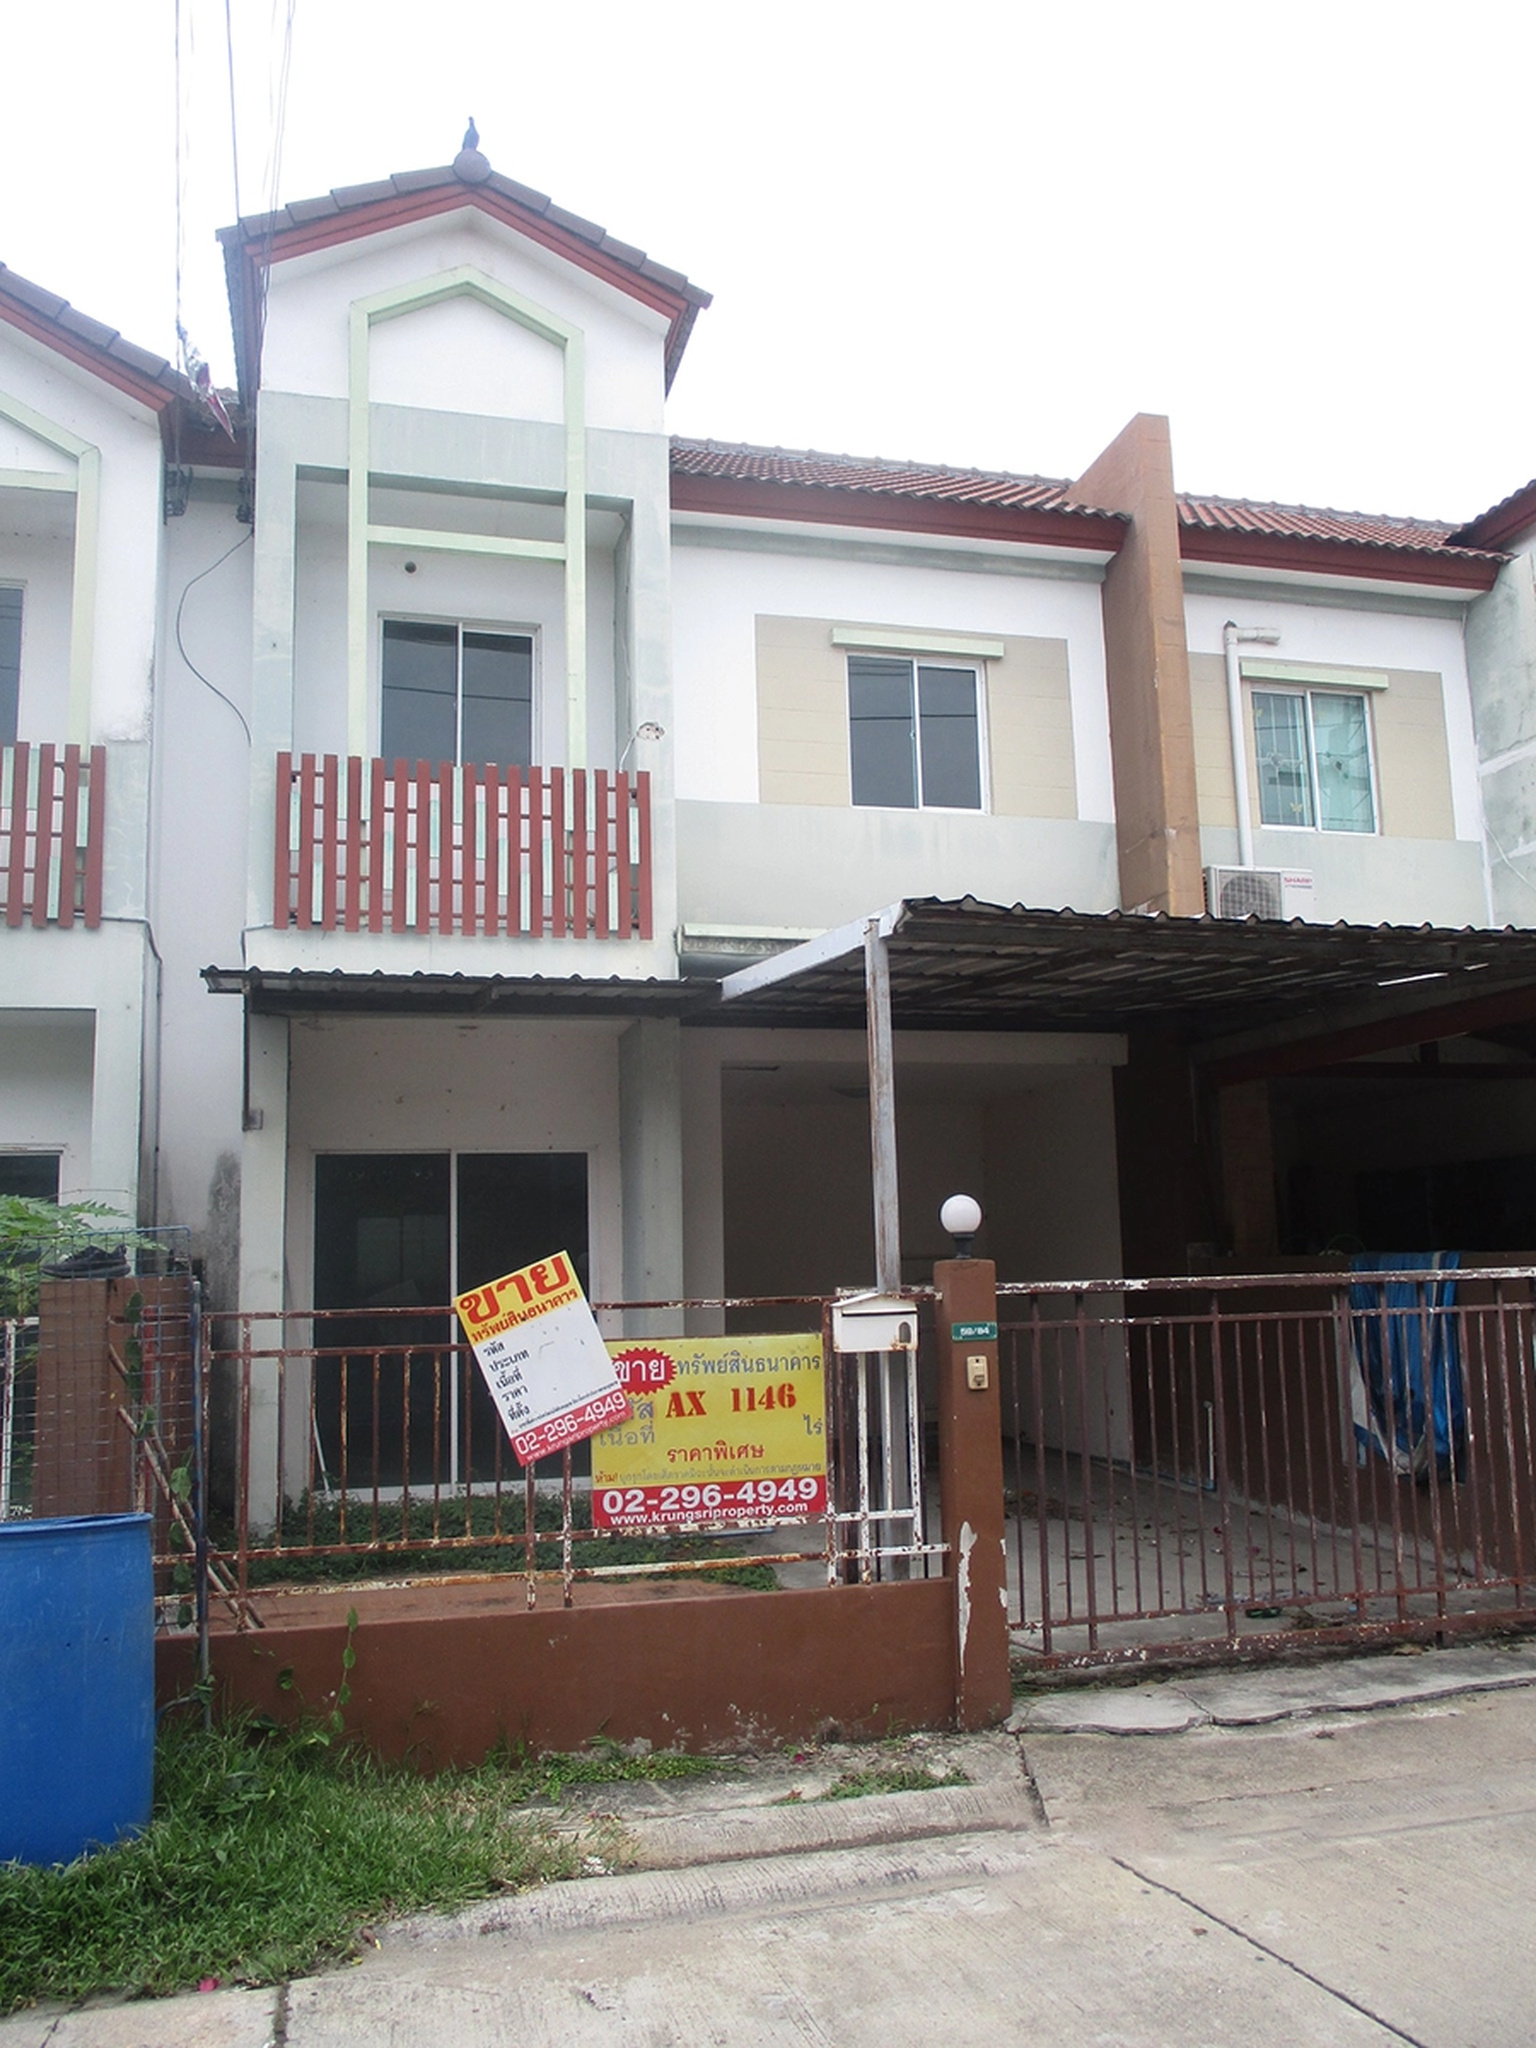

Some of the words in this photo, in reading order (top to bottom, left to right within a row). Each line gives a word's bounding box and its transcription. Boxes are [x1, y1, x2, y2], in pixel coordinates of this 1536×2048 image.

[459, 1255, 570, 1325] ขาย
[471, 1289, 578, 1342] ทรัพย์สินธนาคาร
[483, 1341, 506, 1357] รหัส
[489, 1349, 530, 1373] ประเภท
[613, 1359, 666, 1382] ขาย
[677, 1350, 821, 1375] ทรัพย์สินธนาคาร
[501, 1385, 529, 1402] ราคา
[665, 1390, 707, 1418] AX
[731, 1383, 797, 1412] 1146
[515, 1392, 626, 1455] 02-296-4949
[526, 1411, 627, 1461] www.krungsriproperty.com
[803, 1413, 823, 1435] ไร่
[667, 1439, 765, 1463] ราคาพิเศษ
[603, 1477, 818, 1514] 02-296-4949
[610, 1501, 809, 1525] www.krungsriproperty.com
